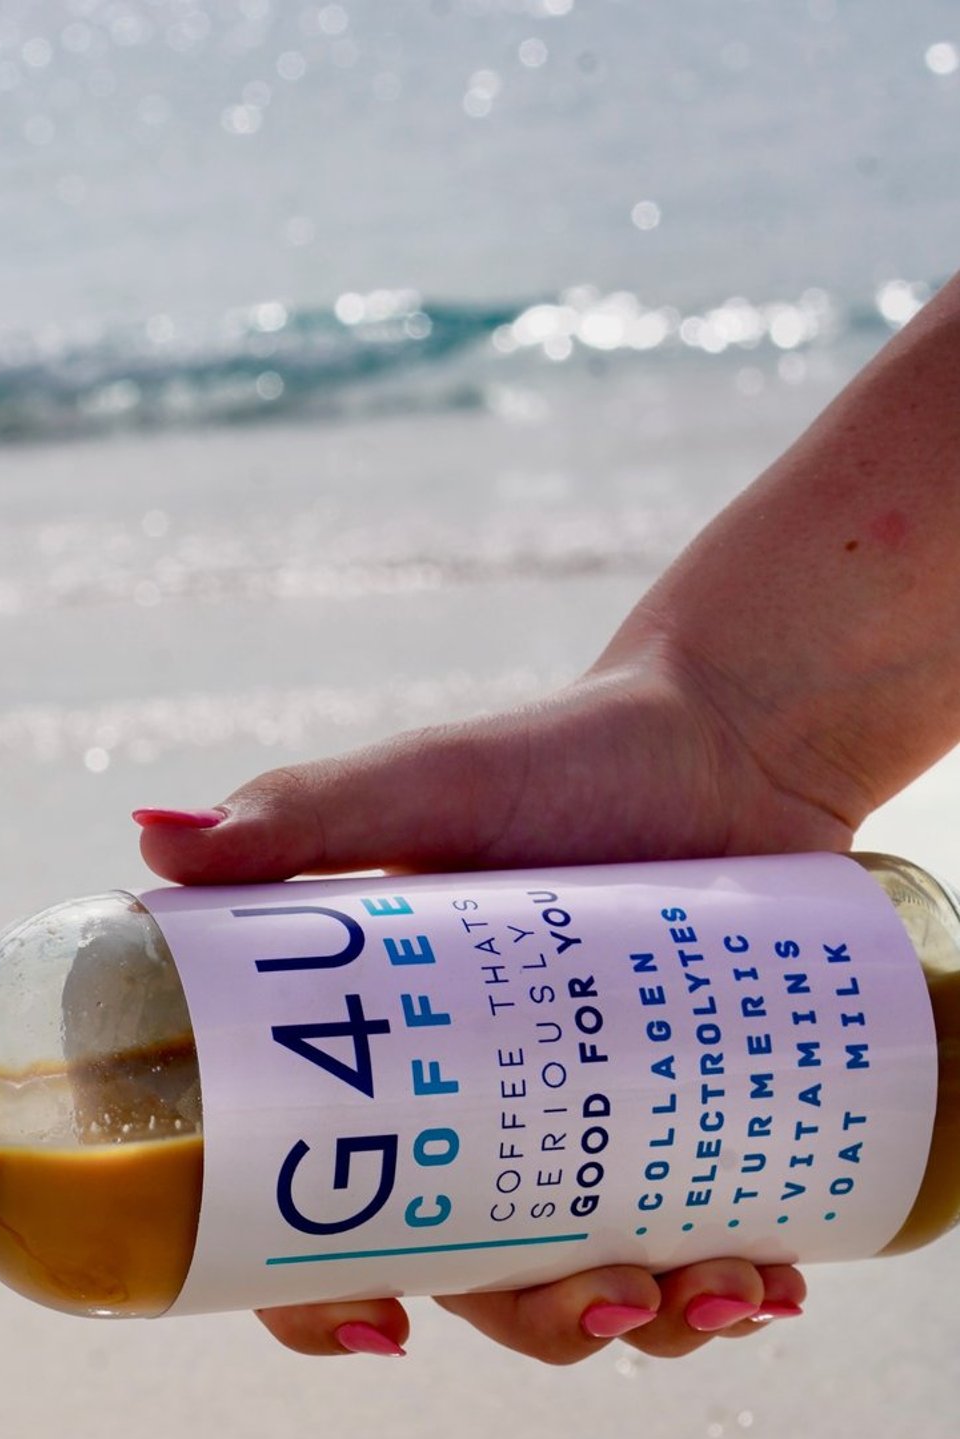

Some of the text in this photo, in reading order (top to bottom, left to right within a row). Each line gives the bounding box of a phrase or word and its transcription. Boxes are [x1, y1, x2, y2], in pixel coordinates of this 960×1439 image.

[230, 906, 398, 1235] G4U
[360, 896, 460, 1228] COFFEE
[453, 899, 526, 1221] COFFEE THATS
[507, 925, 567, 1218] SERIOUSLY
[527, 890, 611, 1217] GOOD FOR YOU
[629, 953, 677, 1211] COLLAGEN
[661, 907, 725, 1207] ELECTROLYTES
[723, 935, 774, 1204] TURMERIC
[775, 940, 822, 1201] VITAMINS
[823, 943, 869, 1195] OAT MILK
